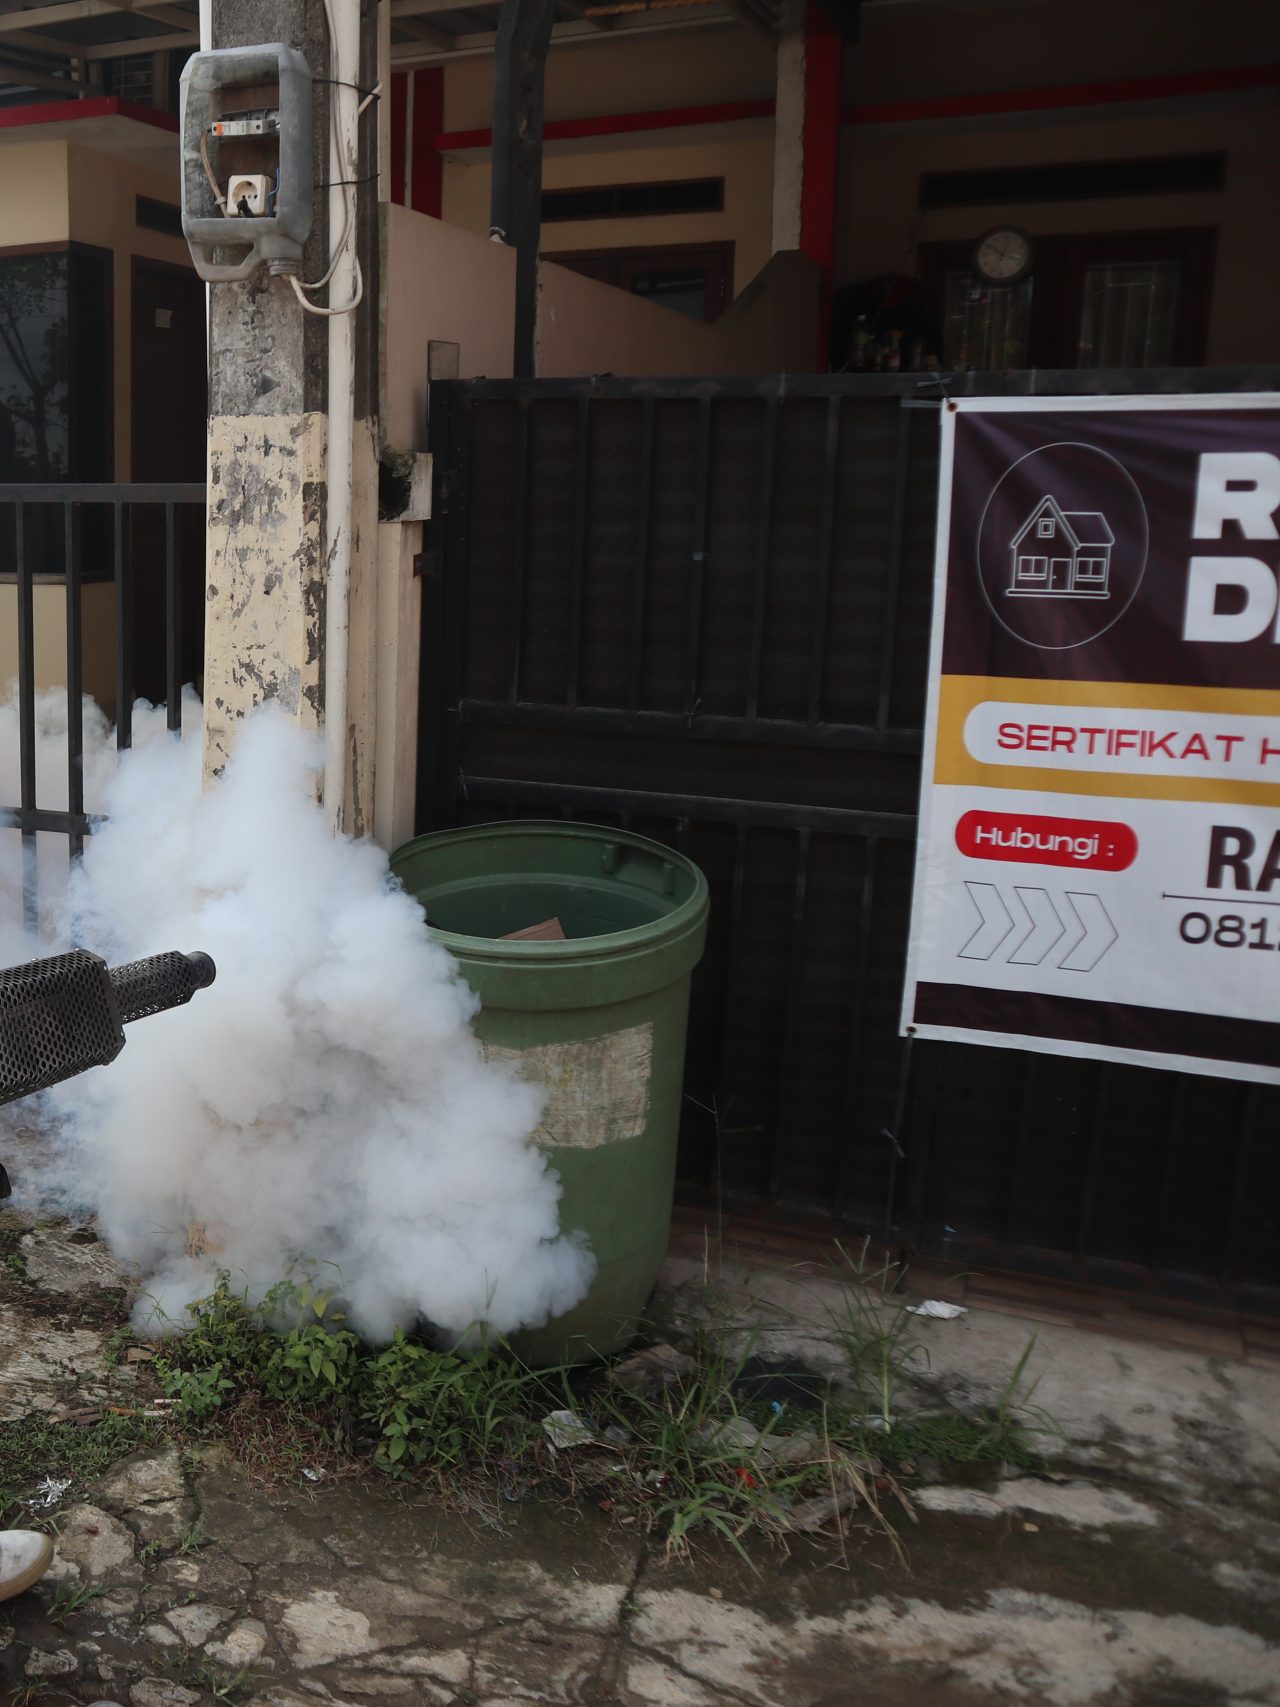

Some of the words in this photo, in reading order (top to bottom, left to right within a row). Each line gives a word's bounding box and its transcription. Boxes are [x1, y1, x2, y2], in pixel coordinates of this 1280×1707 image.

[1182, 556, 1280, 644] D
[997, 722, 1245, 763] SERTIFIKAT
[975, 825, 1100, 860] Hubungi
[1179, 912, 1280, 951] 081
